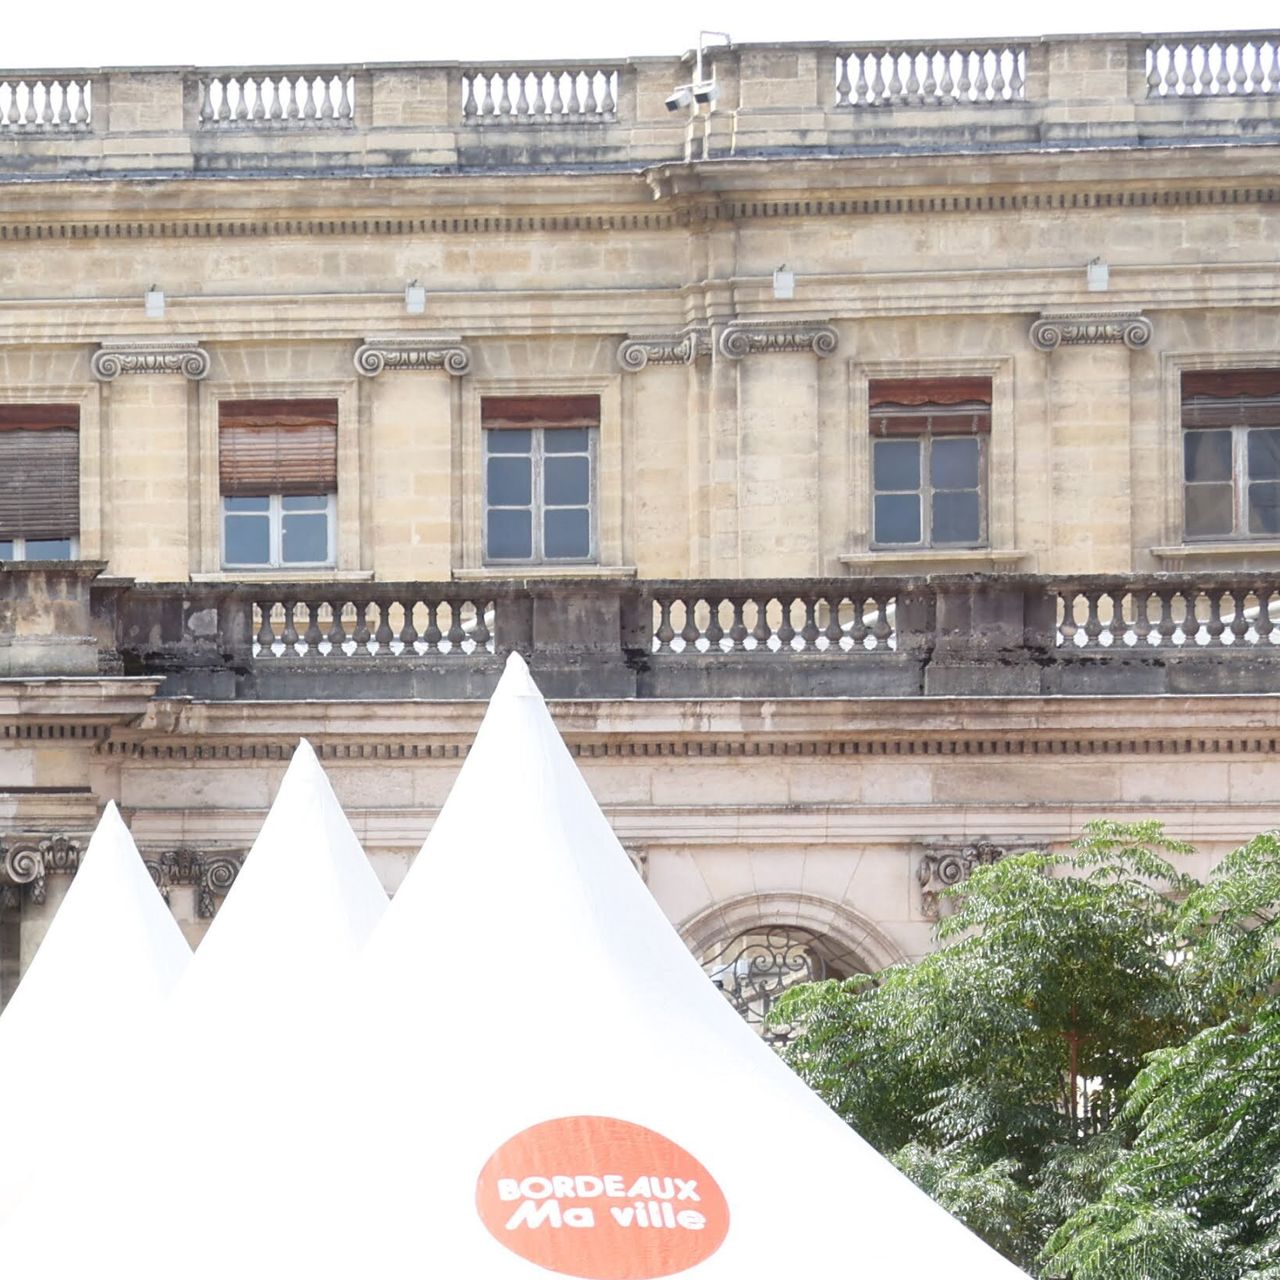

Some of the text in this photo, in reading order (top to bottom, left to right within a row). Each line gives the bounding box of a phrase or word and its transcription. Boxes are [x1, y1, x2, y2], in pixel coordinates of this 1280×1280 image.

[496, 1174, 702, 1202] BORDEAUX
[504, 1199, 708, 1231] Ma ville
